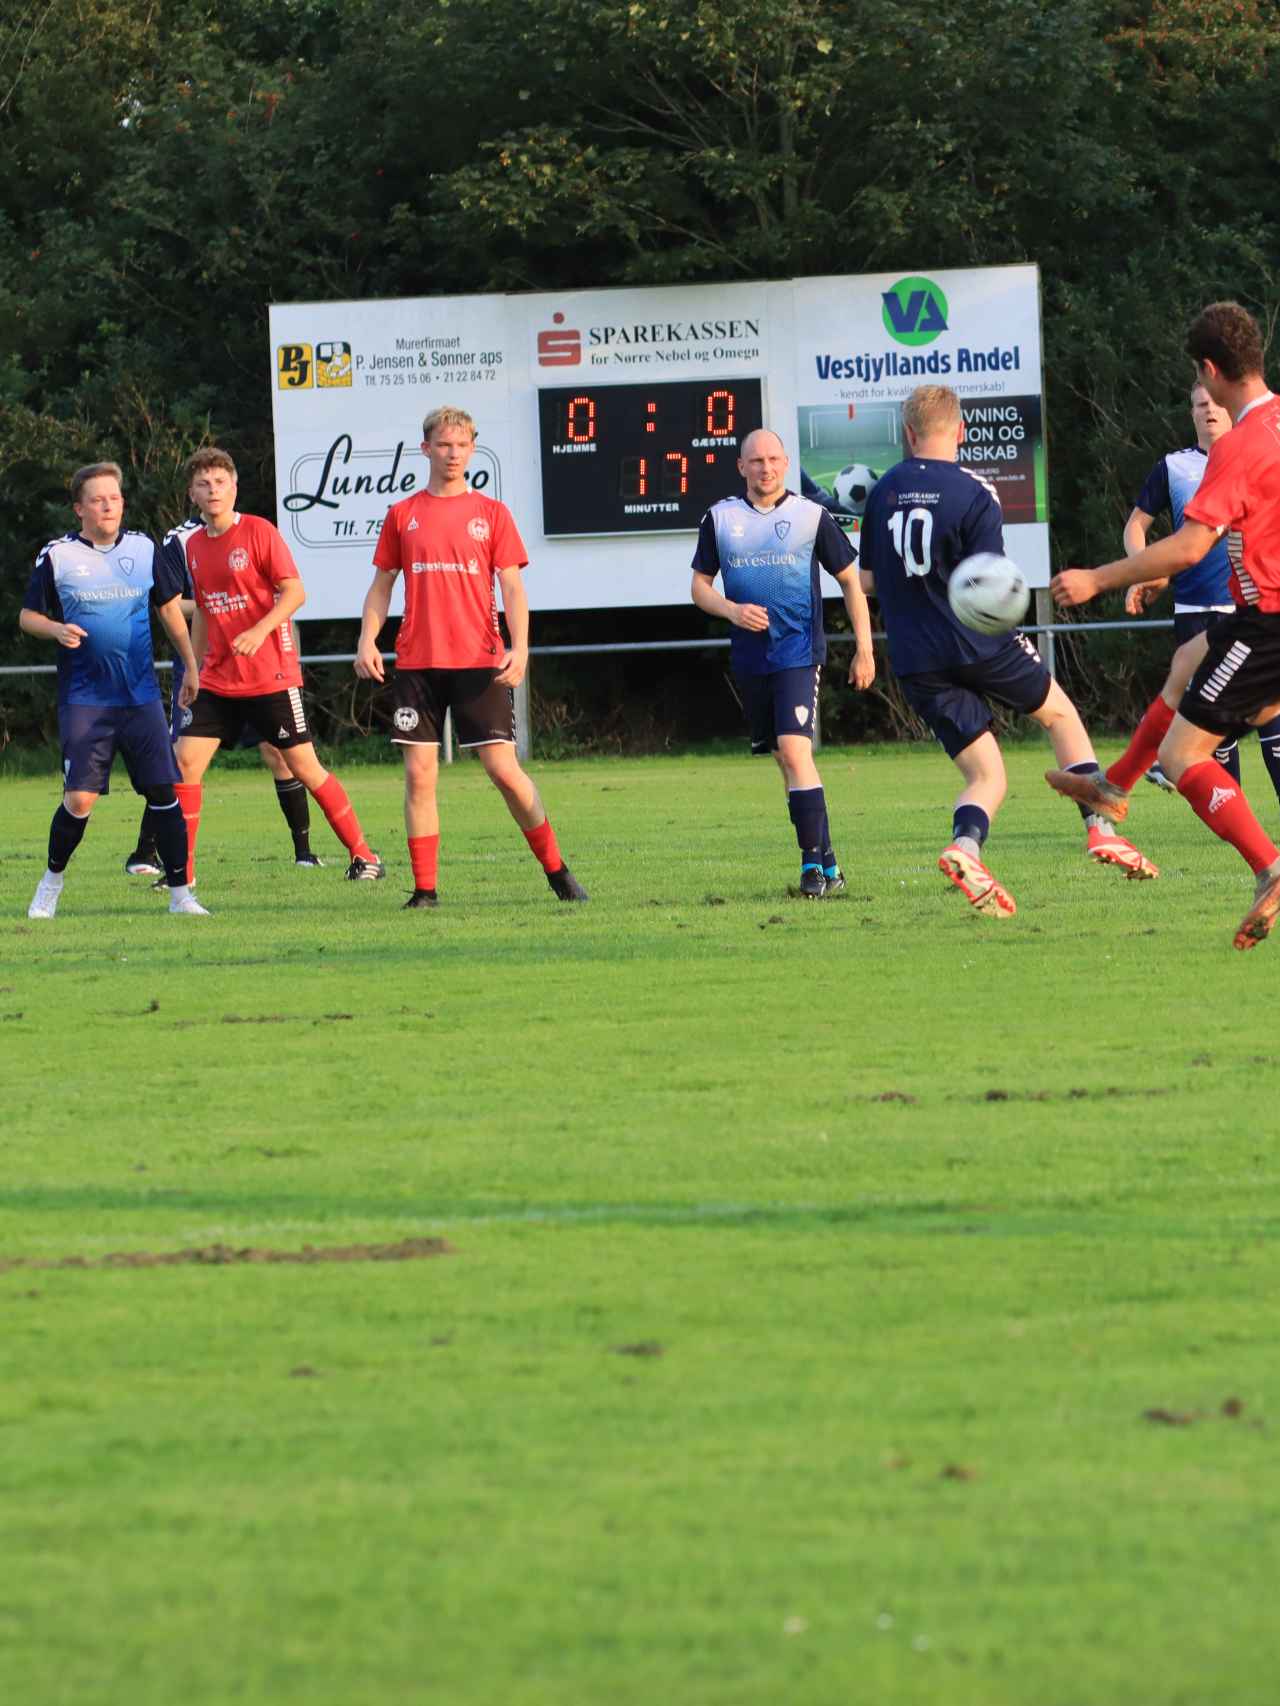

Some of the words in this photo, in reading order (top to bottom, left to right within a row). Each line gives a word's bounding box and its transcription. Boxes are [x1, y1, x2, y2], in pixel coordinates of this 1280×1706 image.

[881, 290, 949, 333] VA
[589, 319, 761, 346] SPAREKASSEN
[396, 336, 460, 350] Murerfirmaet
[356, 355, 365, 370] P.
[369, 354, 414, 369] Jensen
[418, 352, 427, 367] &
[431, 351, 476, 366] Sønner
[480, 351, 503, 366] aps
[591, 353, 609, 366] for
[655, 350, 690, 363] Nebel
[694, 351, 709, 362] og
[713, 348, 759, 361] Omegn
[816, 350, 951, 382] Vestjyllands
[957, 346, 1020, 373] Andel
[408, 373, 418, 384] 15
[486, 370, 496, 381] 72
[568, 397, 595, 442] 0
[707, 391, 734, 435] 0
[692, 437, 737, 448] GÆSTER
[965, 427, 993, 442] ION
[999, 425, 1025, 440] OG
[553, 443, 597, 454] HJEMME
[283, 434, 416, 513] Lunde
[624, 503, 680, 514] MINUTTER
[333, 520, 358, 537] Tlf.
[887, 507, 933, 577] 10
